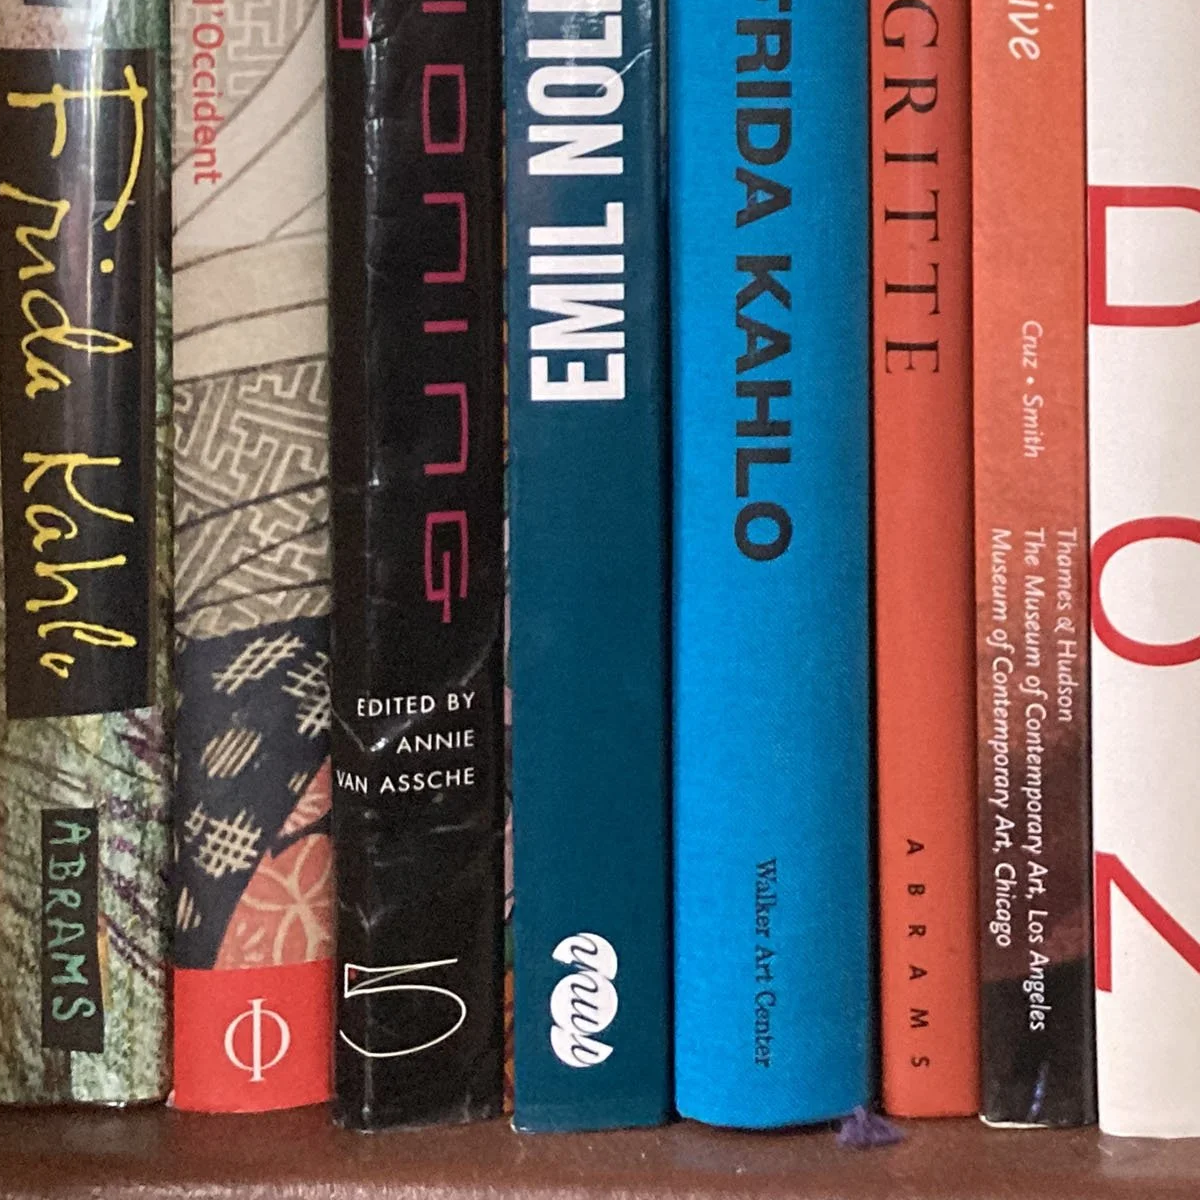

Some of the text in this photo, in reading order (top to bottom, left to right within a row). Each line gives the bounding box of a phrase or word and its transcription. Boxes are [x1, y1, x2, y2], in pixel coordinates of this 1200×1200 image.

[0, 64, 148, 678] Frida Kahlo
[528, 202, 626, 402] EMIL
[1020, 319, 1046, 459] Cruz Smith
[734, 254, 794, 563] KAHLO
[1056, 526, 1078, 612] Thames
[335, 766, 476, 795] VAN ASSCHE
[356, 691, 476, 718] EDITED BY
[396, 728, 476, 755] ANNIE
[985, 527, 1018, 948] Museum of Contemporary Art, Chicago
[1018, 526, 1051, 1032] The Museum of Contemporary Art, Los Angeles
[1056, 639, 1079, 722] Hudson
[42, 818, 99, 1022] ABRAMS
[753, 857, 778, 1069] Walker Art Center
[904, 837, 931, 1070] ABRAMS
